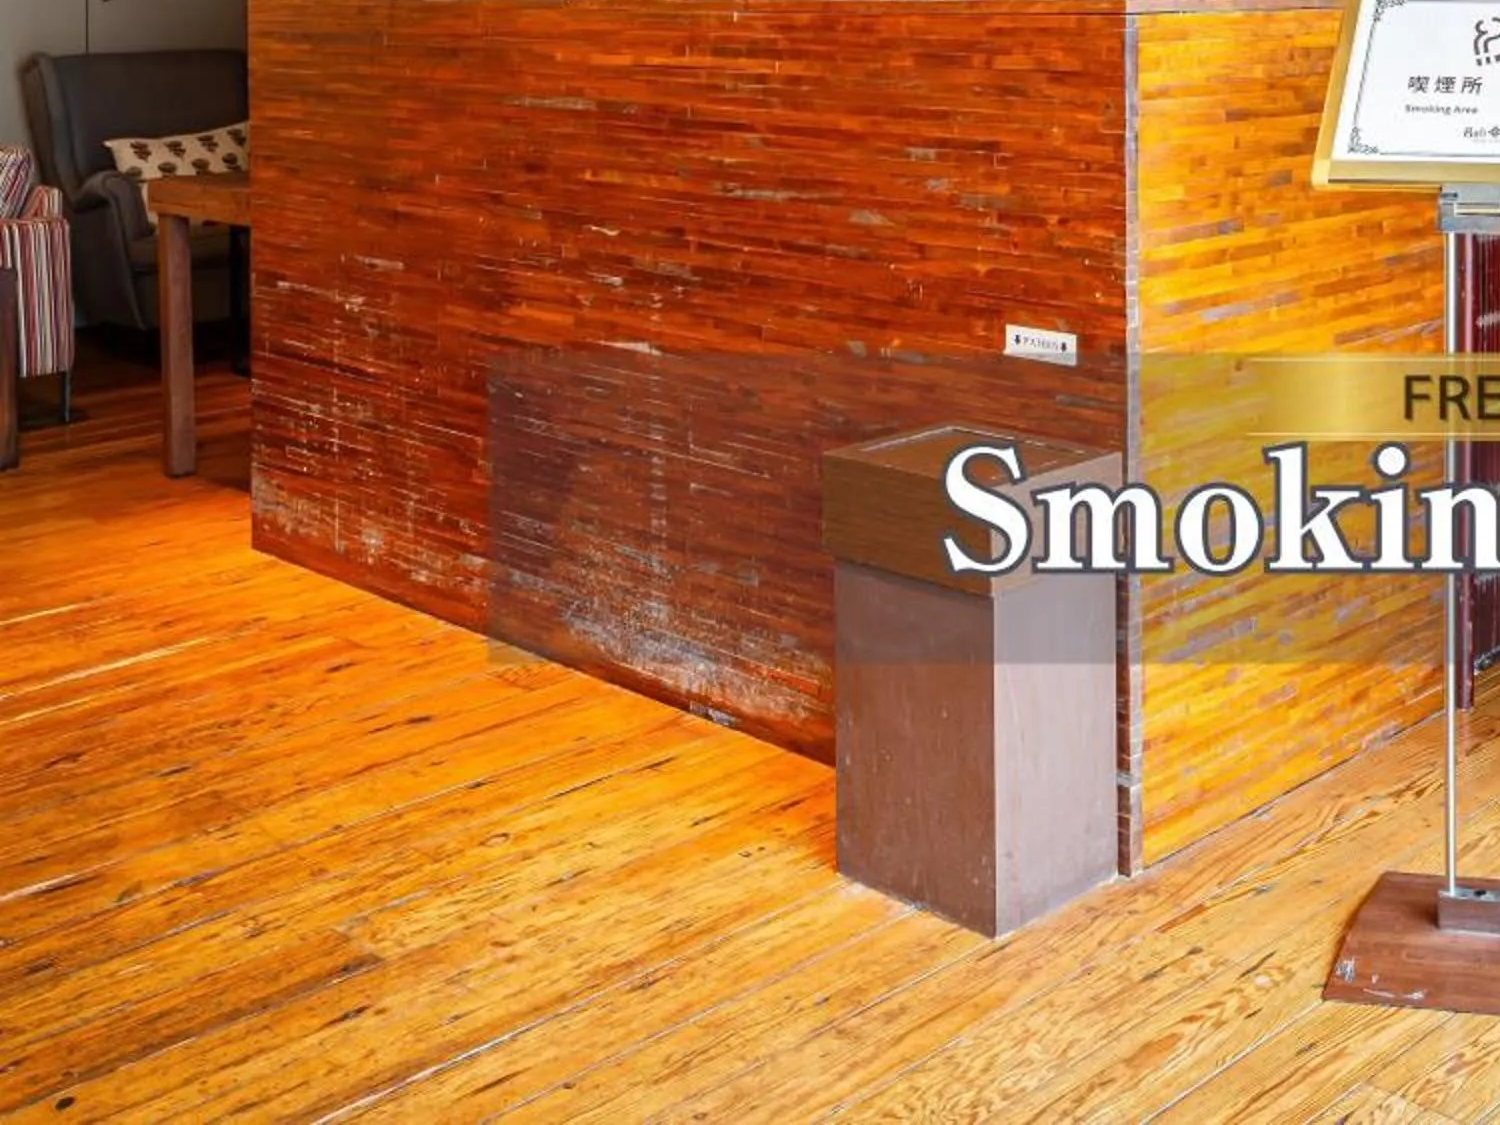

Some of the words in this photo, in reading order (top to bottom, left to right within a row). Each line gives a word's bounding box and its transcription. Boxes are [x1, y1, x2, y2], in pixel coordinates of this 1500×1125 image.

[1408, 75, 1483, 95] 喫煙所
[1404, 104, 1452, 116] Smoking
[1453, 105, 1479, 115] Area
